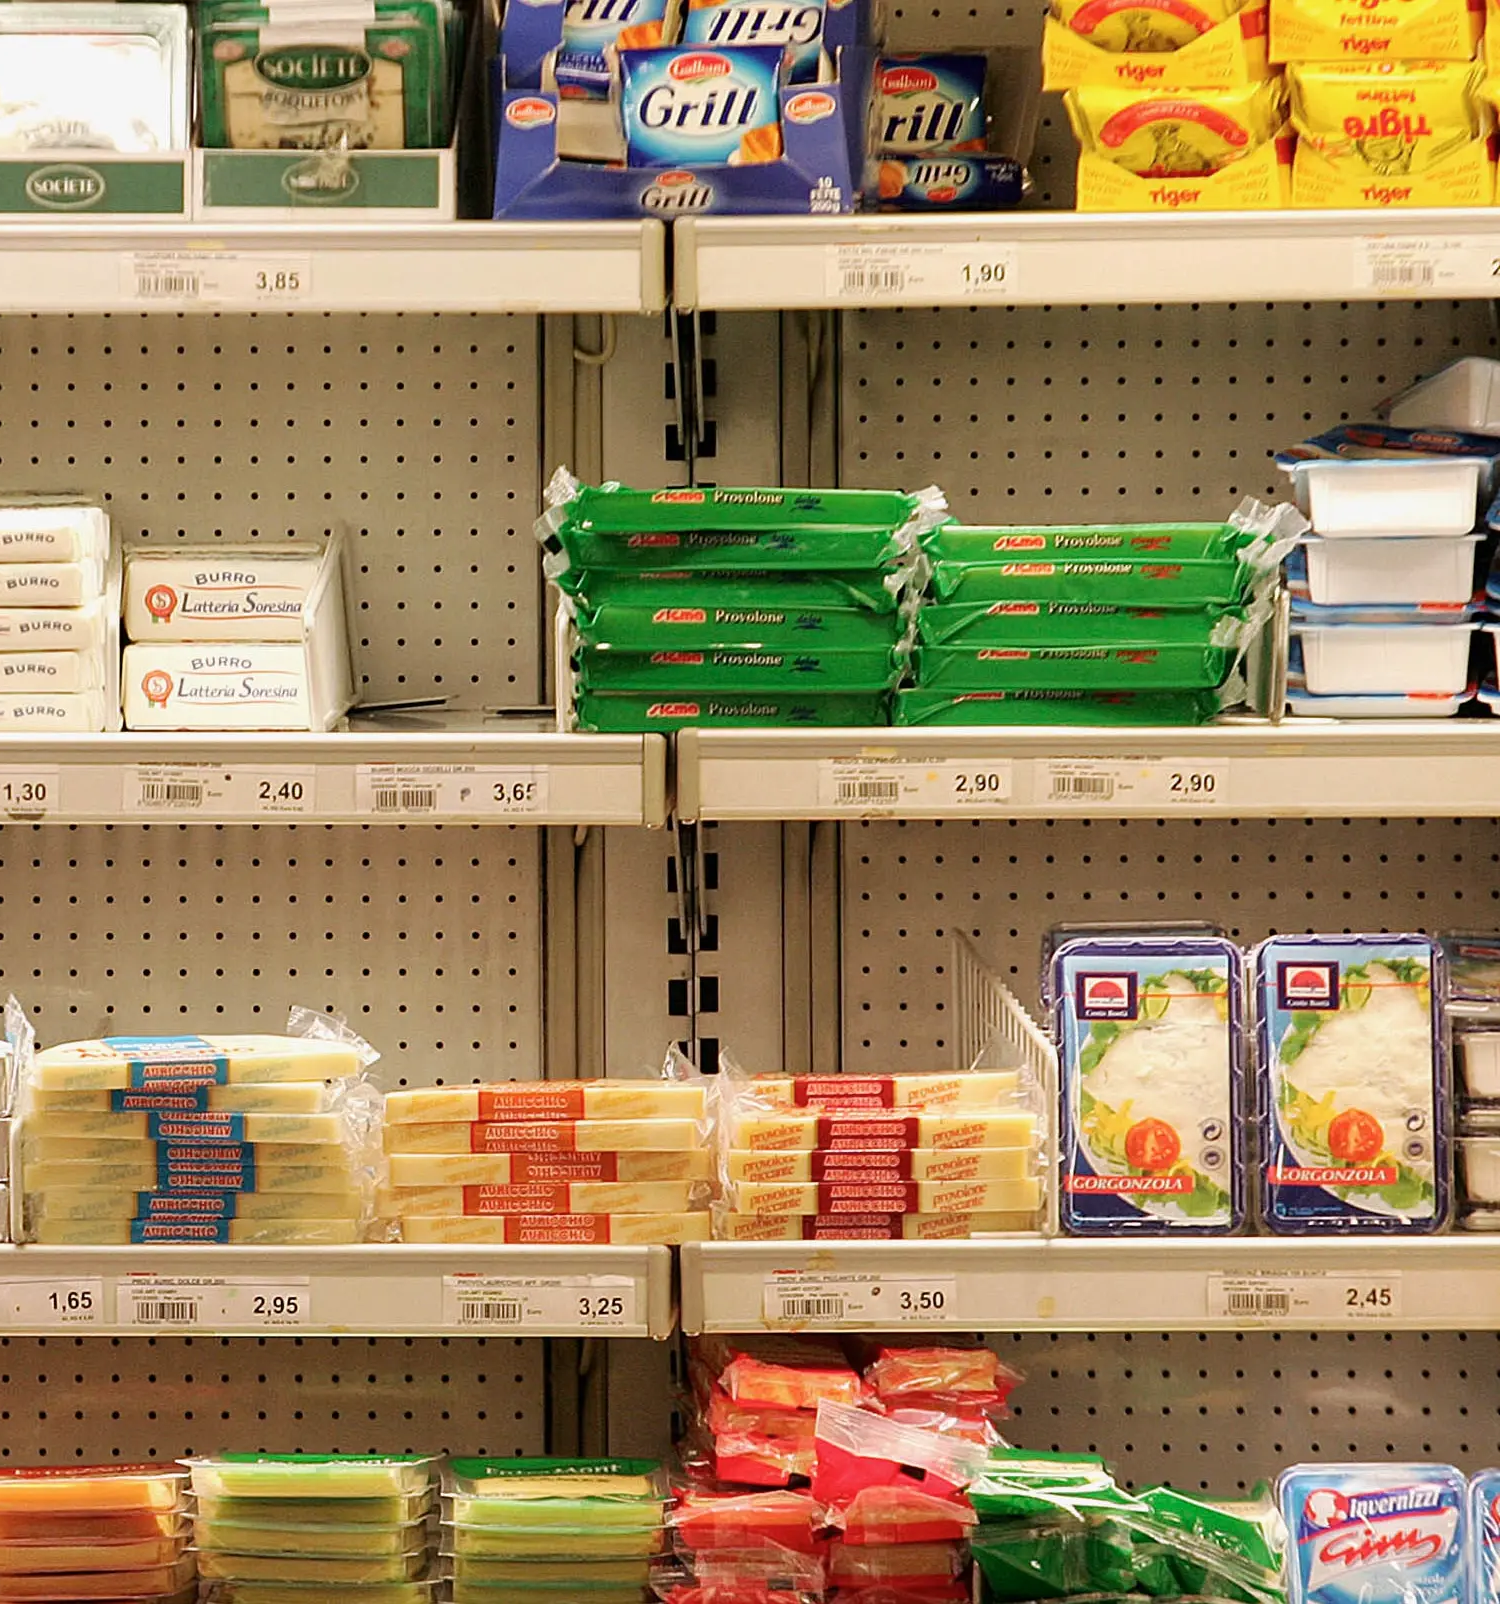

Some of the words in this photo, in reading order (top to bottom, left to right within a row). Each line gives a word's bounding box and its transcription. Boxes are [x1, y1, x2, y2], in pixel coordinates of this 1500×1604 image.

[710, 9, 821, 43] Grill
[639, 85, 760, 129] Grill
[914, 162, 970, 184] Grill
[639, 186, 713, 211] Grill
[256, 271, 300, 291] 3,85
[962, 263, 1006, 285] 1,90
[714, 491, 784, 505] Provolone
[2, 533, 55, 546] BURRO
[688, 532, 758, 545] Provolone
[1054, 535, 1123, 548] Provolone
[1063, 562, 1132, 574] Provolone
[7, 577, 60, 591] BURRO
[194, 572, 256, 586] BURRO
[181, 592, 239, 613] Latteria
[243, 592, 302, 613] Soresina
[1048, 602, 1117, 614] Provolone
[715, 610, 785, 624] Provolone
[19, 621, 72, 634] BURRO
[713, 653, 783, 666] Provolone
[1040, 648, 1108, 659] Provolone
[191, 656, 252, 670] BURRO
[4, 664, 56, 677] BURRO
[177, 678, 235, 698] Latteria
[239, 676, 298, 698] Soresina
[13, 706, 66, 718] BURRO
[708, 703, 778, 716] Provolone
[259, 780, 303, 801] 2,40
[955, 773, 999, 794] 2,90
[1170, 773, 1215, 794] 2,90
[3, 783, 46, 803] 1,30
[493, 783, 537, 804] 3,65
[143, 1065, 216, 1077] AURICCHIO
[806, 1082, 882, 1095] AURICCHIO
[123, 1097, 197, 1109] AURICCHIO
[493, 1097, 567, 1108] AURICCHIO
[485, 1127, 558, 1139] AURICCHIO
[830, 1123, 906, 1136] AURICCHIO
[824, 1155, 899, 1167] AURICCHIO
[1276, 1168, 1387, 1182] GORGONZOLA
[1073, 1176, 1184, 1191] GORGONZOLA
[830, 1185, 906, 1197] AURICCHIO
[150, 1198, 224, 1210] AURICCHIO
[478, 1199, 555, 1211] AURICCHIO
[829, 1200, 906, 1212] AURICCHIO
[143, 1225, 217, 1237] AURICCHIO
[49, 1292, 93, 1312] 1,65
[900, 1291, 944, 1311] 3,50
[1346, 1288, 1391, 1309] 2,45
[254, 1296, 299, 1316] 2,95
[579, 1298, 623, 1317] 3,25
[1348, 1490, 1440, 1518] Invernizzi
